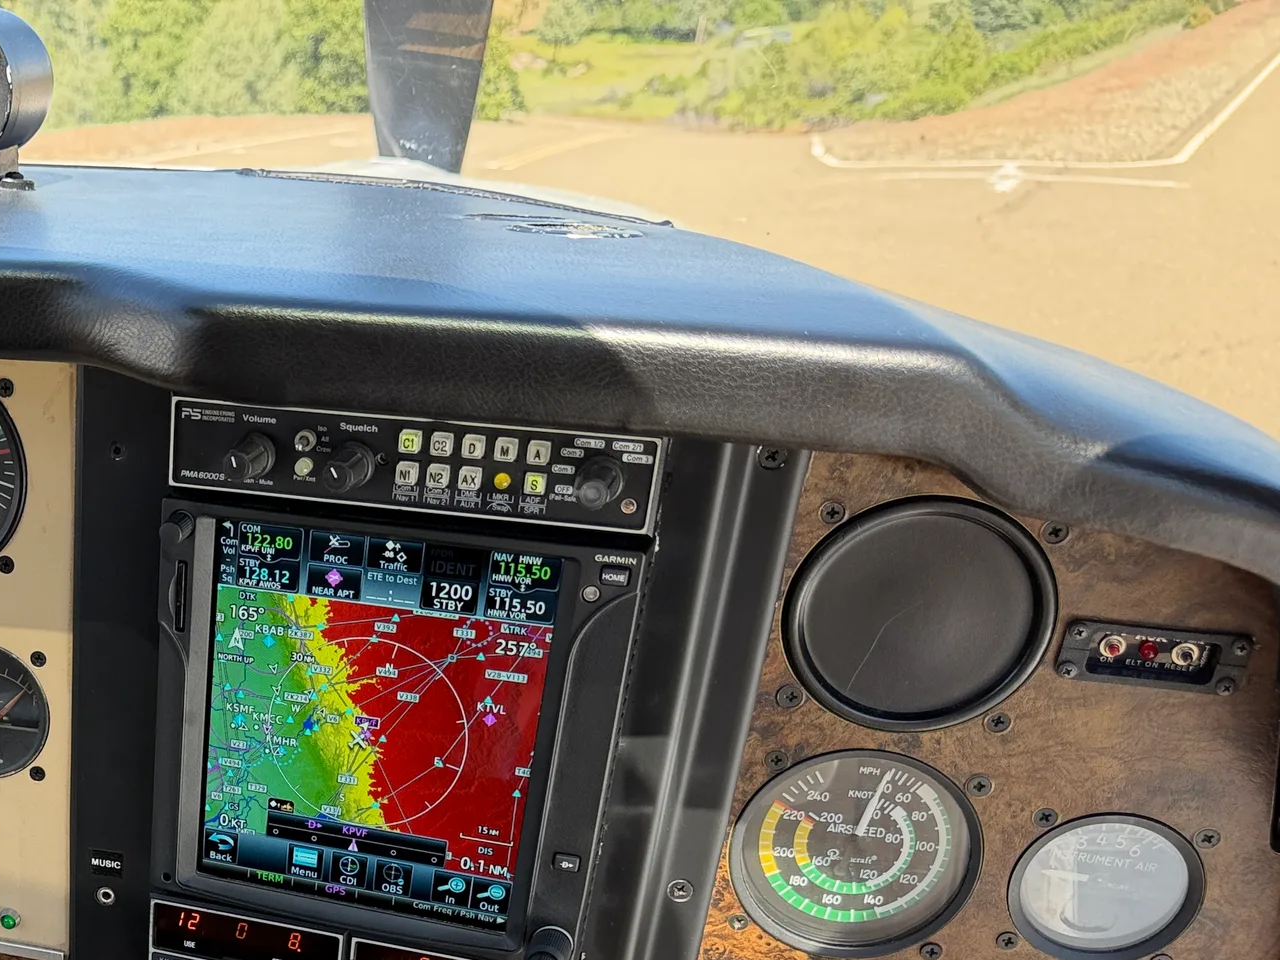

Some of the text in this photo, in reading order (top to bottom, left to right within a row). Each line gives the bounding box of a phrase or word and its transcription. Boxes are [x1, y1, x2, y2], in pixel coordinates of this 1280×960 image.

[243, 413, 277, 424] Volume
[340, 422, 378, 433] Squelch
[403, 438, 415, 449] C1
[433, 441, 447, 452] C2
[627, 455, 643, 463] Com
[461, 474, 477, 487] AX
[241, 524, 261, 533] COM
[246, 533, 293, 550] 122.80
[261, 547, 275, 555] UNI
[239, 558, 260, 568] STBY
[324, 555, 348, 564] PROC
[494, 552, 542, 565] NAV HNW
[595, 554, 637, 565] GARMIN
[379, 560, 408, 572] Traffic
[499, 562, 551, 580] 115.50
[245, 567, 290, 583] 128.12
[367, 572, 417, 585] ETE to Dest
[602, 572, 625, 582] HOME
[259, 580, 281, 589] AWOS
[430, 581, 472, 599] 1200
[239, 592, 256, 600] DTK
[312, 586, 355, 599] NEAR APT
[489, 588, 514, 598] STBY
[433, 599, 464, 612] STBY
[493, 597, 546, 615] 115.50
[230, 605, 264, 621] 165°
[255, 624, 284, 636] KBAB
[495, 639, 536, 656] 257°
[1125, 658, 1158, 669] ELT ON
[226, 703, 255, 714] KSMF
[477, 702, 506, 715] KTVL
[267, 735, 297, 747] KMHR
[859, 766, 880, 776] MPH
[820, 812, 843, 823] 200
[342, 826, 368, 838] KPVF
[773, 847, 794, 858] 200
[915, 842, 934, 852] 100
[210, 851, 232, 863] Back
[91, 857, 121, 870] MUSIC
[1135, 860, 1158, 872] AIR
[256, 870, 284, 883] TERM
[291, 866, 318, 879] Menu
[340, 876, 357, 886] CDI
[789, 875, 808, 887] 180
[899, 874, 918, 885] 120
[325, 885, 346, 895] GPS
[381, 884, 403, 895] OBS
[445, 895, 455, 904] In
[822, 894, 841, 905] 160
[864, 894, 883, 905] 140
[413, 901, 494, 923] Com Freq Psh Nav
[479, 901, 500, 913] Out
